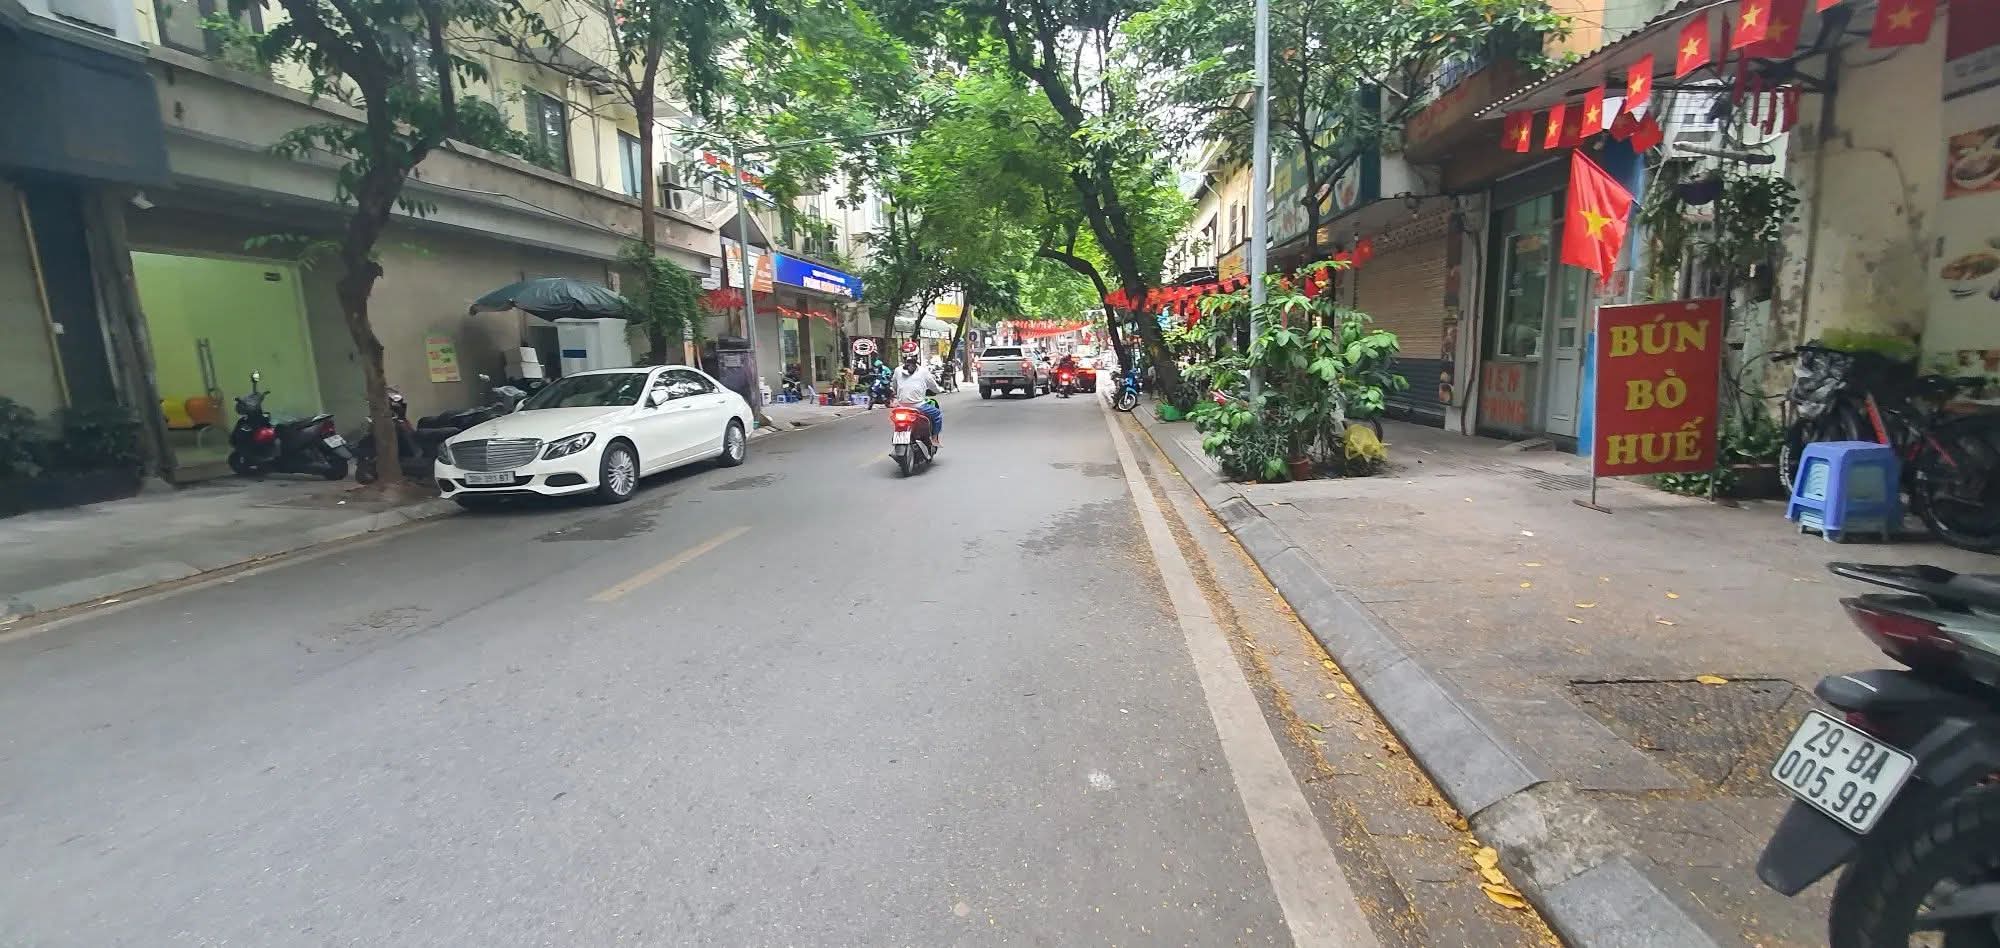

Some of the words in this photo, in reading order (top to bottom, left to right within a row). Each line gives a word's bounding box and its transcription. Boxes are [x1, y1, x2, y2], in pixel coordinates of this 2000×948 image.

[1609, 314, 1709, 357] BÚN
[1625, 368, 1687, 411] BÒ
[1606, 416, 1705, 465] HUẾ
[1803, 720, 1890, 784] 29-BA
[1778, 750, 1877, 824] 005.98
